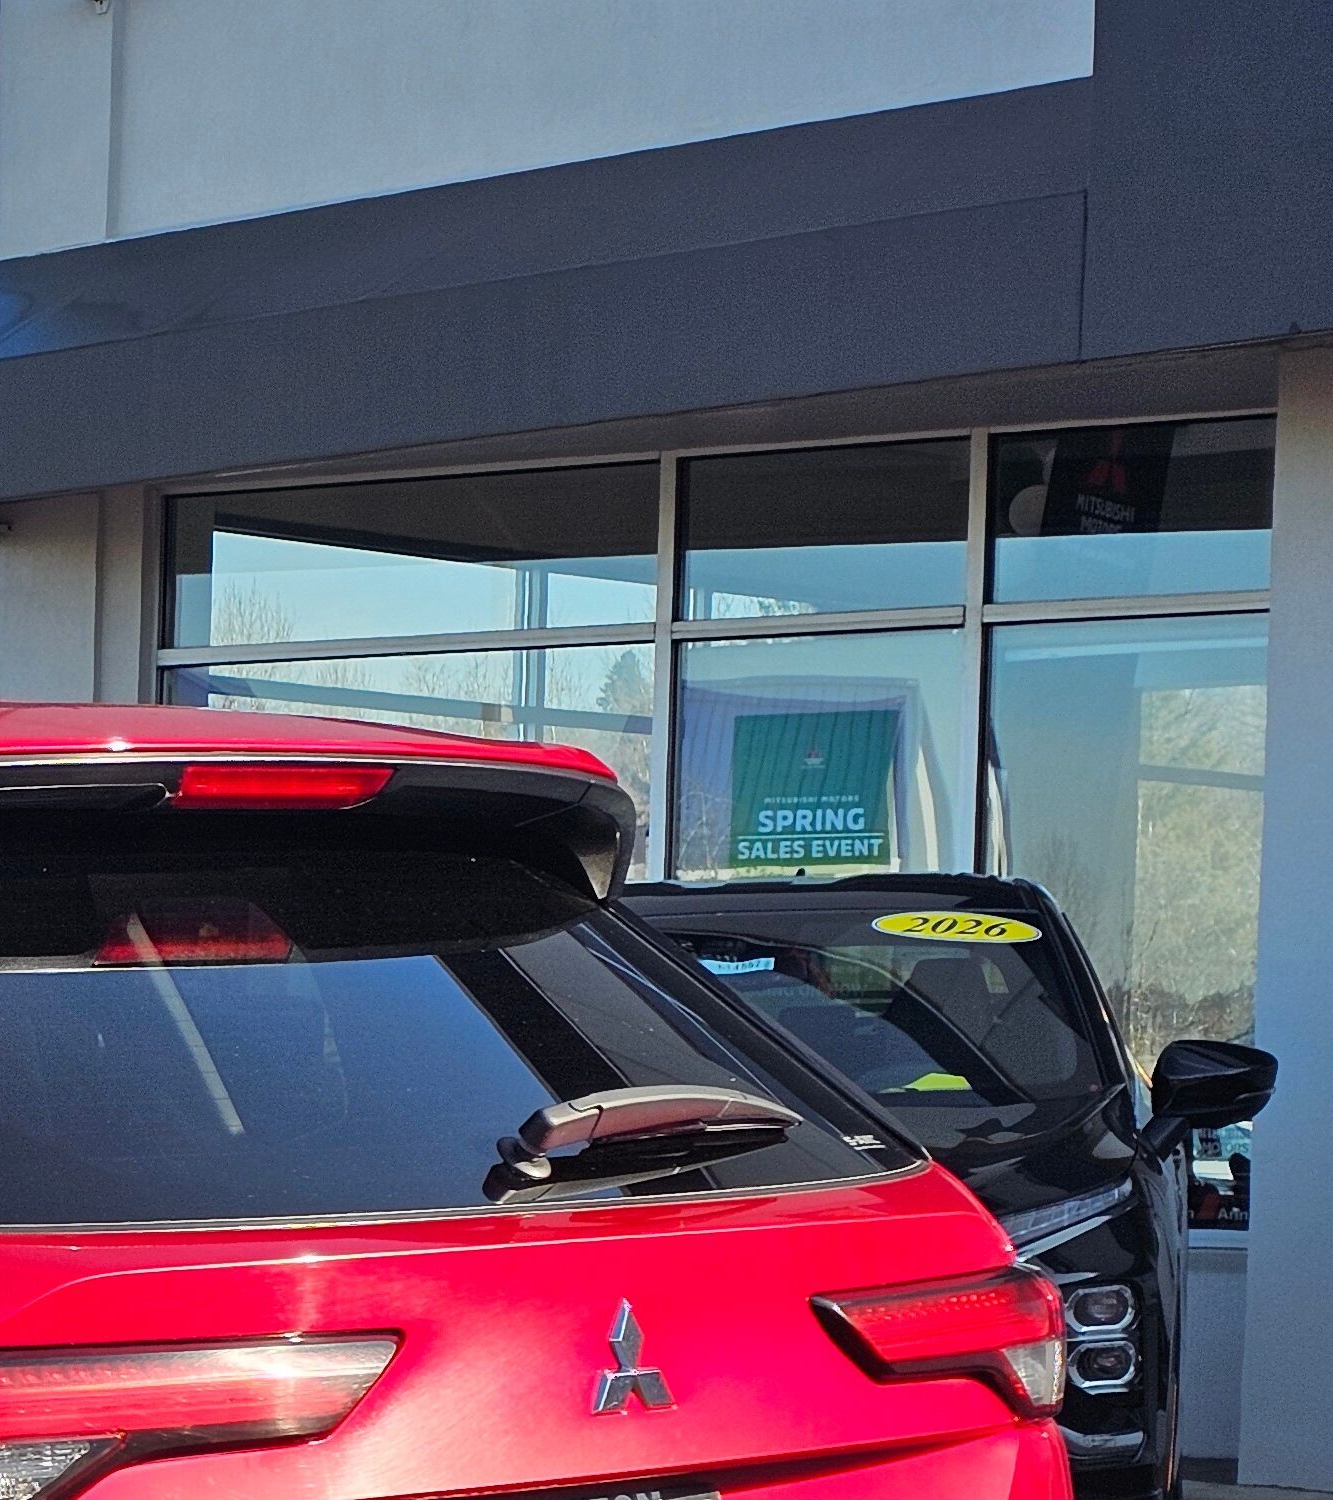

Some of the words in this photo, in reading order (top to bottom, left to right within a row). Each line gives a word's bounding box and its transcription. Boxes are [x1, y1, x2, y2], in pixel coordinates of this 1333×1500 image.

[757, 807, 866, 834] SPRING
[736, 836, 805, 860] SALES
[810, 837, 884, 860] EVENT
[903, 916, 1009, 939] 2026
